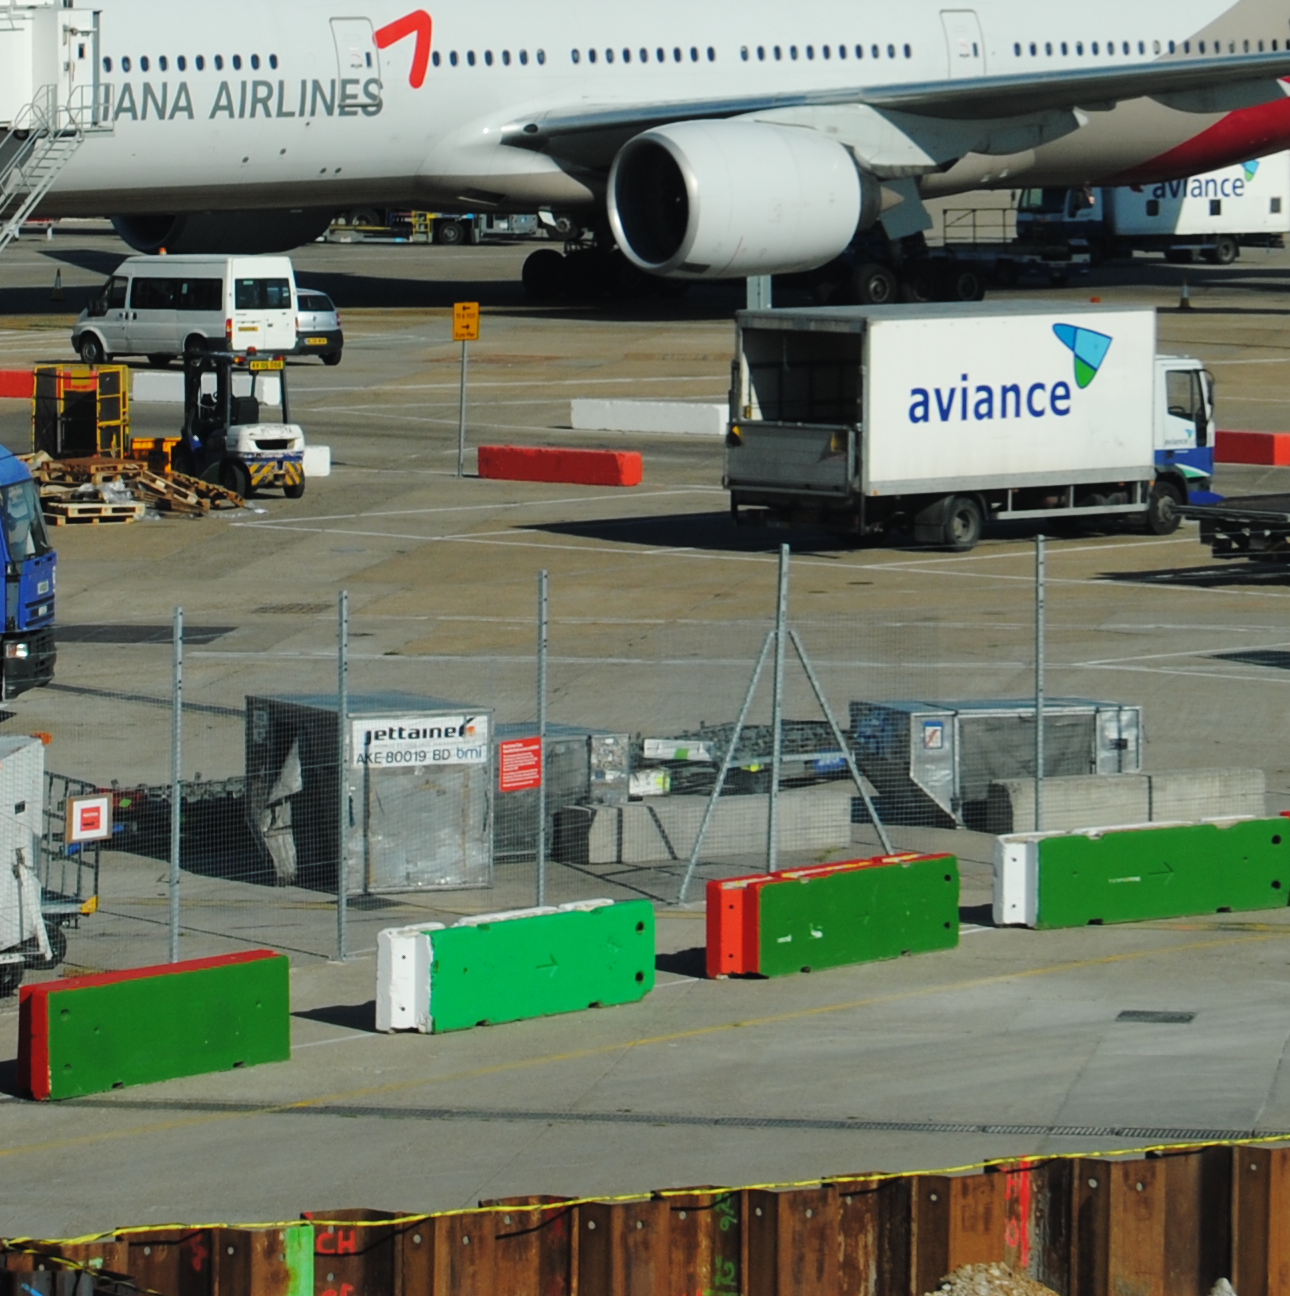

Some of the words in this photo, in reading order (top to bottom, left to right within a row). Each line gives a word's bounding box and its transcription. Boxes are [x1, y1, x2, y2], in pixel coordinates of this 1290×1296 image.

[102, 81, 195, 121] IANA
[208, 78, 384, 120] AIRLINES
[1152, 177, 1245, 199] aviance
[908, 373, 1072, 424] aviance
[364, 717, 477, 746] jettainer
[356, 752, 382, 765] AKE
[385, 750, 427, 764] 80019
[432, 748, 451, 761] BD
[456, 745, 482, 760] bmi
[315, 1231, 357, 1255] CH
